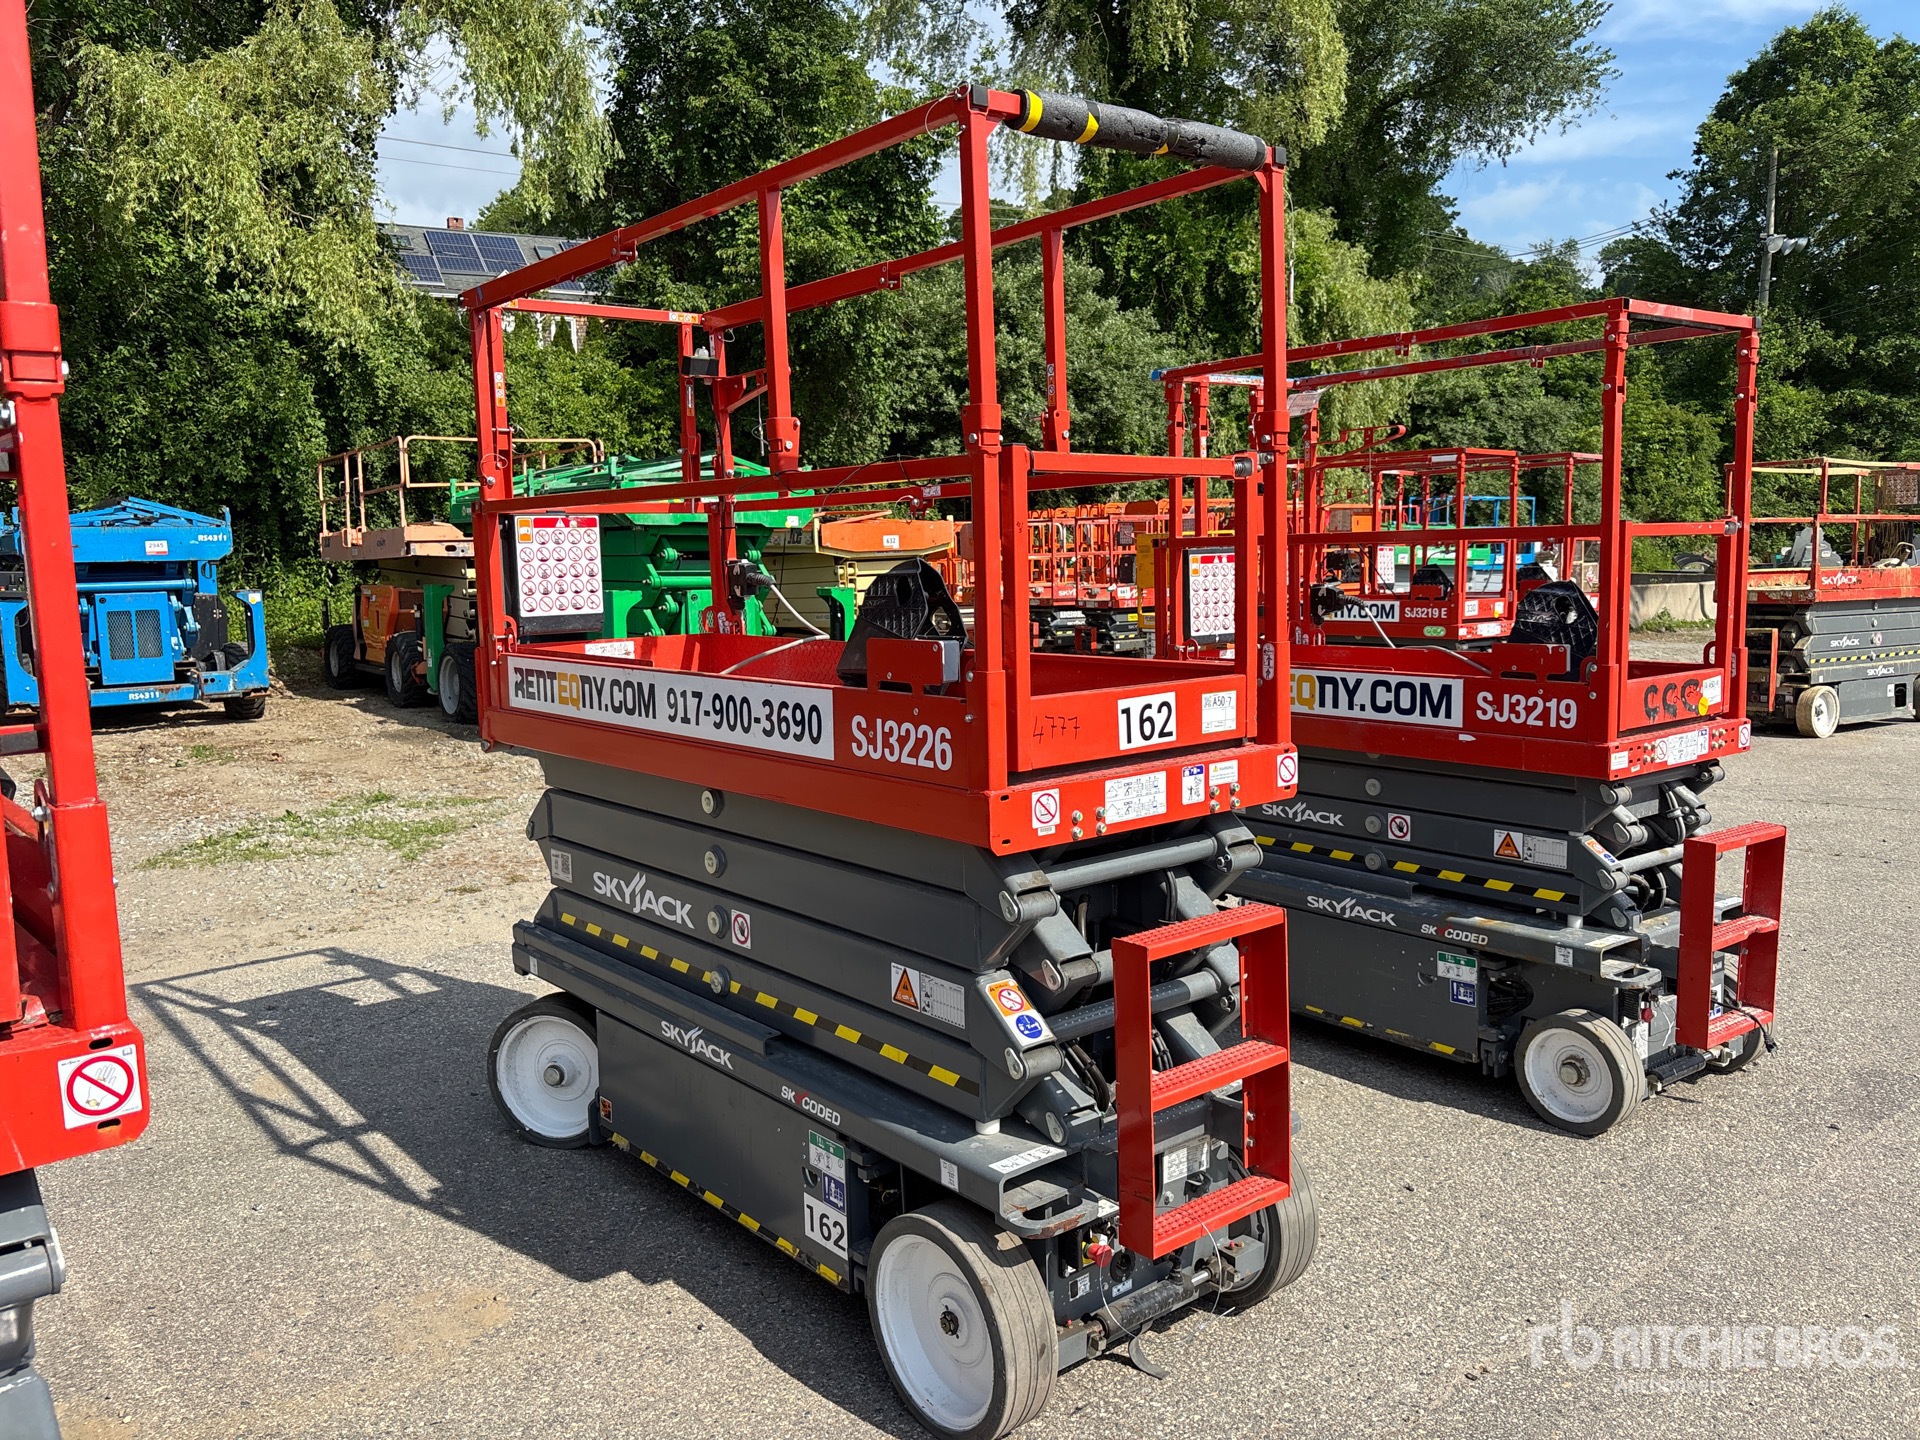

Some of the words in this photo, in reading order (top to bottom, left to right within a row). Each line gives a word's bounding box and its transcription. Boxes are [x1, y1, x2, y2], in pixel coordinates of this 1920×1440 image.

[1404, 606, 1439, 619] SJ3219
[1440, 608, 1448, 619] E
[666, 687, 823, 745] 917-900-3690
[1291, 674, 1453, 720] QNY.COM
[1475, 691, 1578, 729] SJ3219
[851, 714, 953, 771] SJ3226
[1120, 700, 1174, 744] 162
[1261, 801, 1345, 827] SKYJACK
[593, 871, 696, 930] SKYJACK
[1306, 895, 1398, 927] SKYJACK
[660, 1020, 734, 1071] SKYJACK
[806, 1203, 846, 1252] 162
